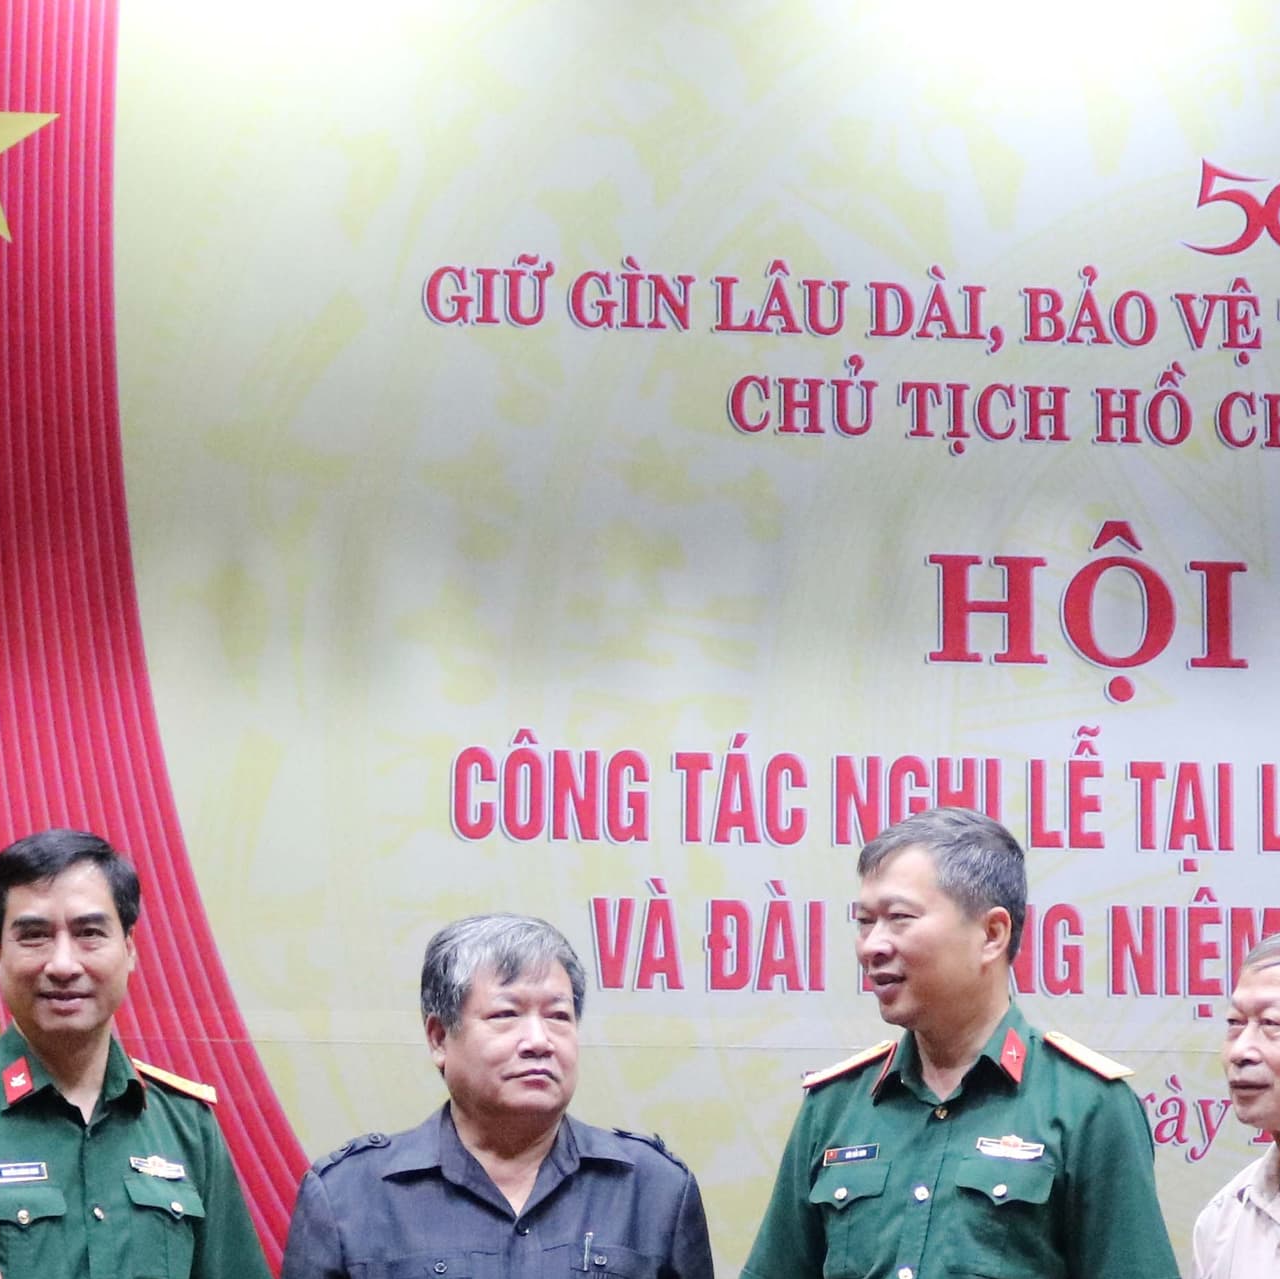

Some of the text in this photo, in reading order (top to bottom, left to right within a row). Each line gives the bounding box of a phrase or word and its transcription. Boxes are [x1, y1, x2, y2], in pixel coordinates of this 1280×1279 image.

[426, 254, 555, 327] GIỮ
[571, 256, 695, 330] GÌN
[715, 259, 849, 336] LÂU
[869, 266, 1004, 353] DÀI,
[1024, 265, 1159, 347] BẢO
[1174, 278, 1262, 365] VỆ
[731, 354, 878, 436] CHỦ
[901, 381, 1071, 455] TỊCH
[1096, 362, 1193, 446] HỒ
[930, 521, 1248, 703] HỘI
[454, 728, 649, 842] CÔNG
[676, 733, 806, 845] TÁC
[835, 755, 1002, 844] NGHI
[1031, 726, 1104, 849] LỄ
[1130, 761, 1233, 872] TẠI
[593, 878, 683, 990] VÀ
[708, 880, 824, 992] ĐÀI
[1142, 1074, 1232, 1161] ày
